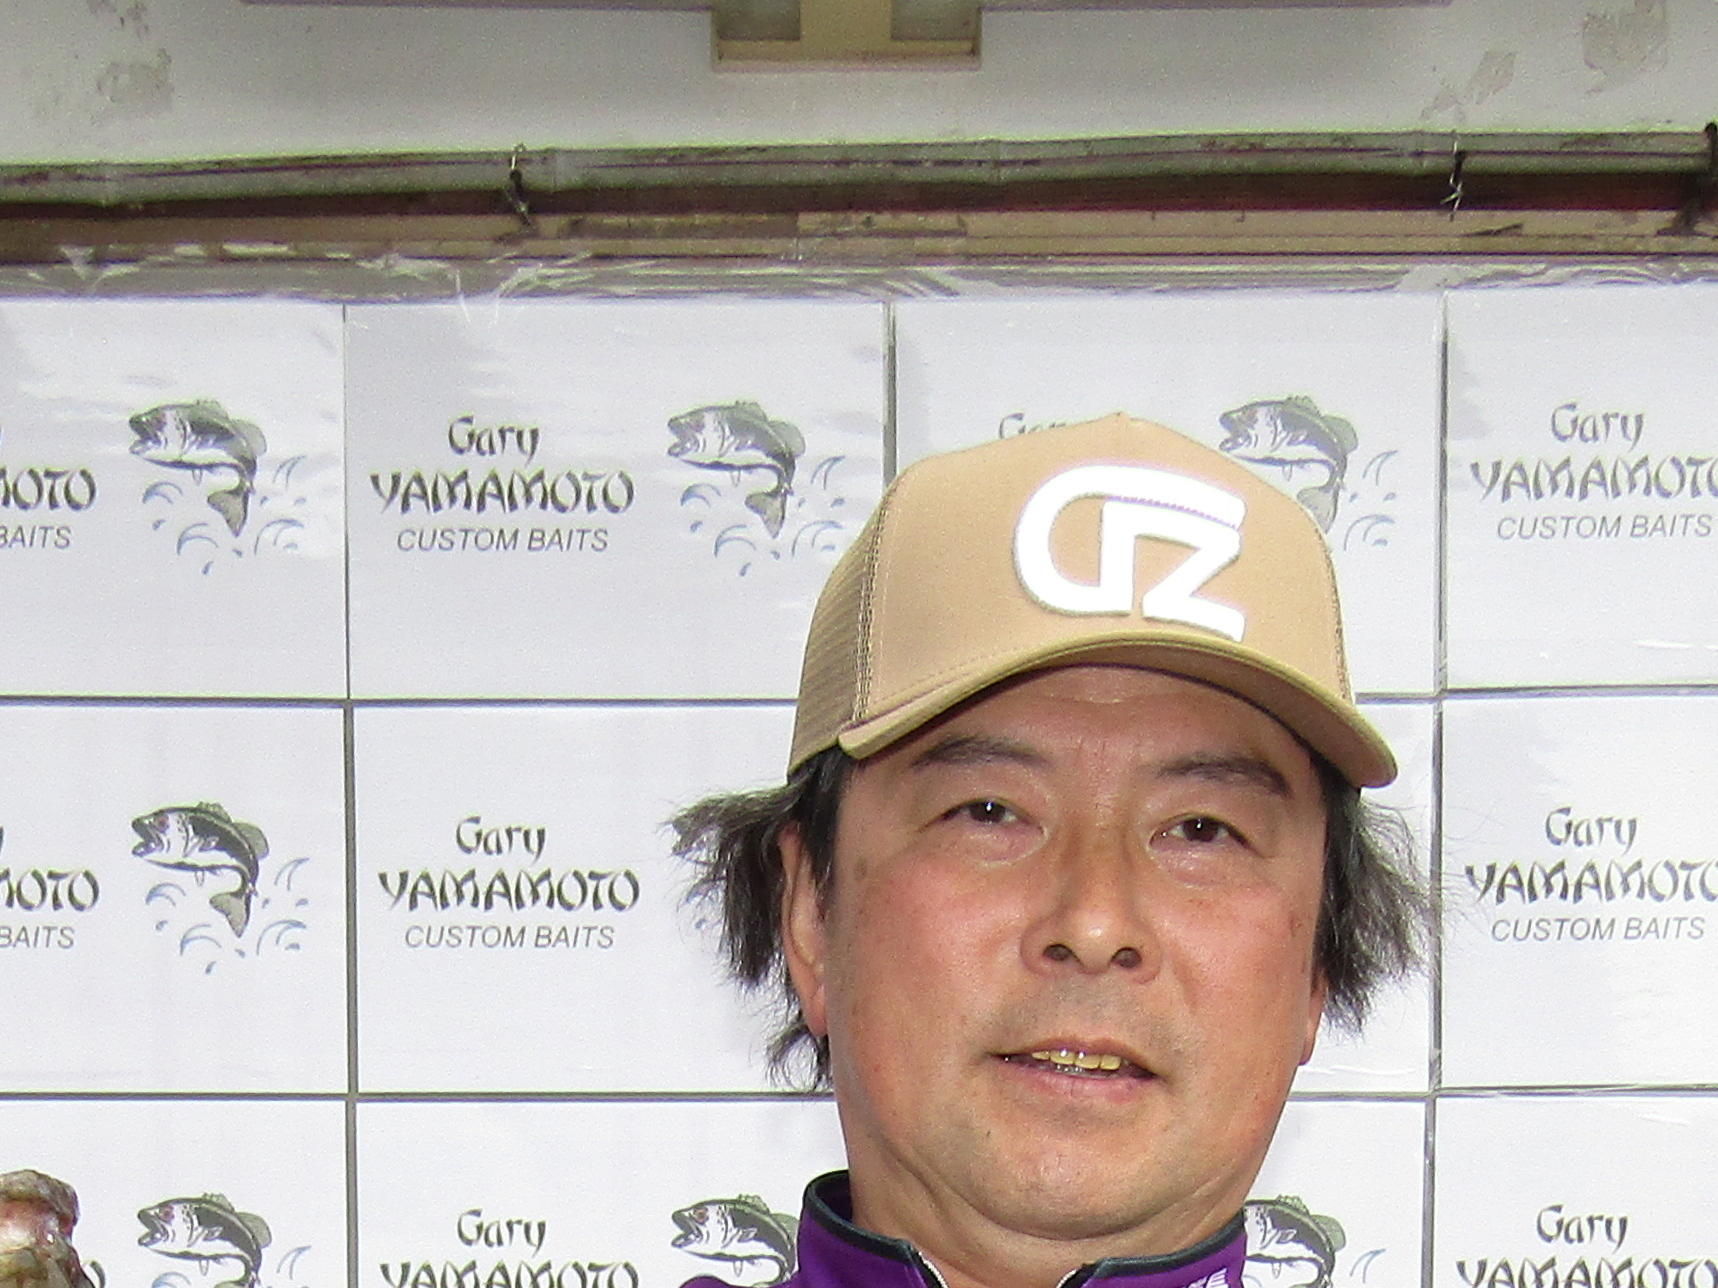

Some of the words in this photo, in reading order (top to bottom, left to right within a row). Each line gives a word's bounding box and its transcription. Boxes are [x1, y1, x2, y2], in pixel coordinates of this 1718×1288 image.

[448, 415, 541, 466] Gary
[1552, 402, 1645, 449] Gary
[371, 469, 636, 516] YAMAMOTO
[397, 527, 521, 554] CUSTOM
[528, 527, 610, 554] BAITS
[1498, 513, 1623, 541] CUSTOM
[1630, 513, 1714, 541] BAITS
[456, 815, 547, 866] Gary
[1546, 806, 1638, 853] Gary
[378, 868, 641, 913] YAMAMOTO
[405, 924, 528, 951] CUSTOM
[534, 924, 616, 951] BAITS
[1492, 916, 1617, 943] CUSTOM
[1624, 916, 1706, 943] BAITS
[457, 1208, 547, 1258] Gary
[1537, 1204, 1629, 1254] Gary
